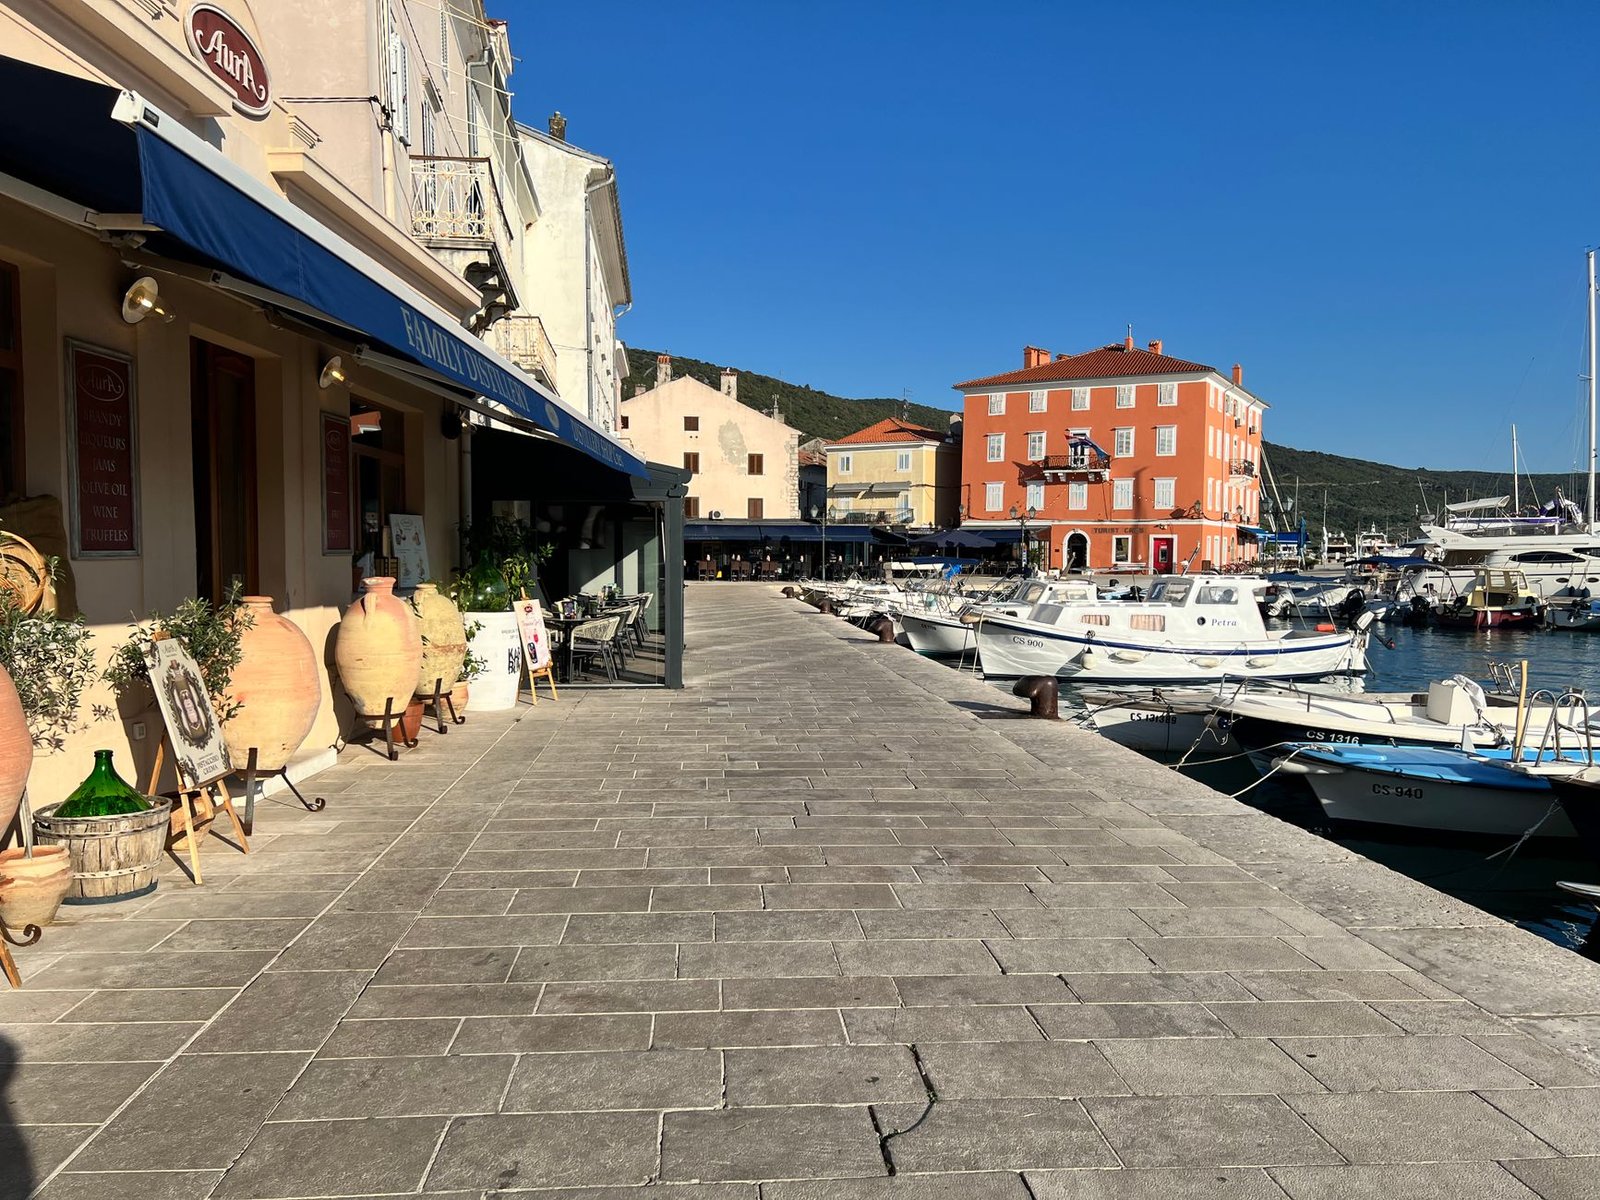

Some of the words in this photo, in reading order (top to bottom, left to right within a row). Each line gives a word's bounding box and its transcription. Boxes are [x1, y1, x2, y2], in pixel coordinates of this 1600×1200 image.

[400, 305, 465, 376] FAMILY
[463, 348, 531, 413] DISTILLERY
[80, 432, 127, 451] LIQUEURS
[91, 458, 117, 473] JAMS
[81, 480, 110, 495] OLIVE
[111, 483, 128, 496] OIL
[92, 505, 118, 519] WINE
[85, 528, 129, 542] TRUFFLES
[1211, 618, 1237, 626] Petra
[1012, 635, 1025, 645] CS
[1027, 639, 1044, 648] 900
[1130, 712, 1142, 722] CS
[1306, 729, 1326, 741] CS
[1329, 733, 1360, 745] 1316
[1371, 783, 1391, 796] CS
[1394, 786, 1424, 800] 940
